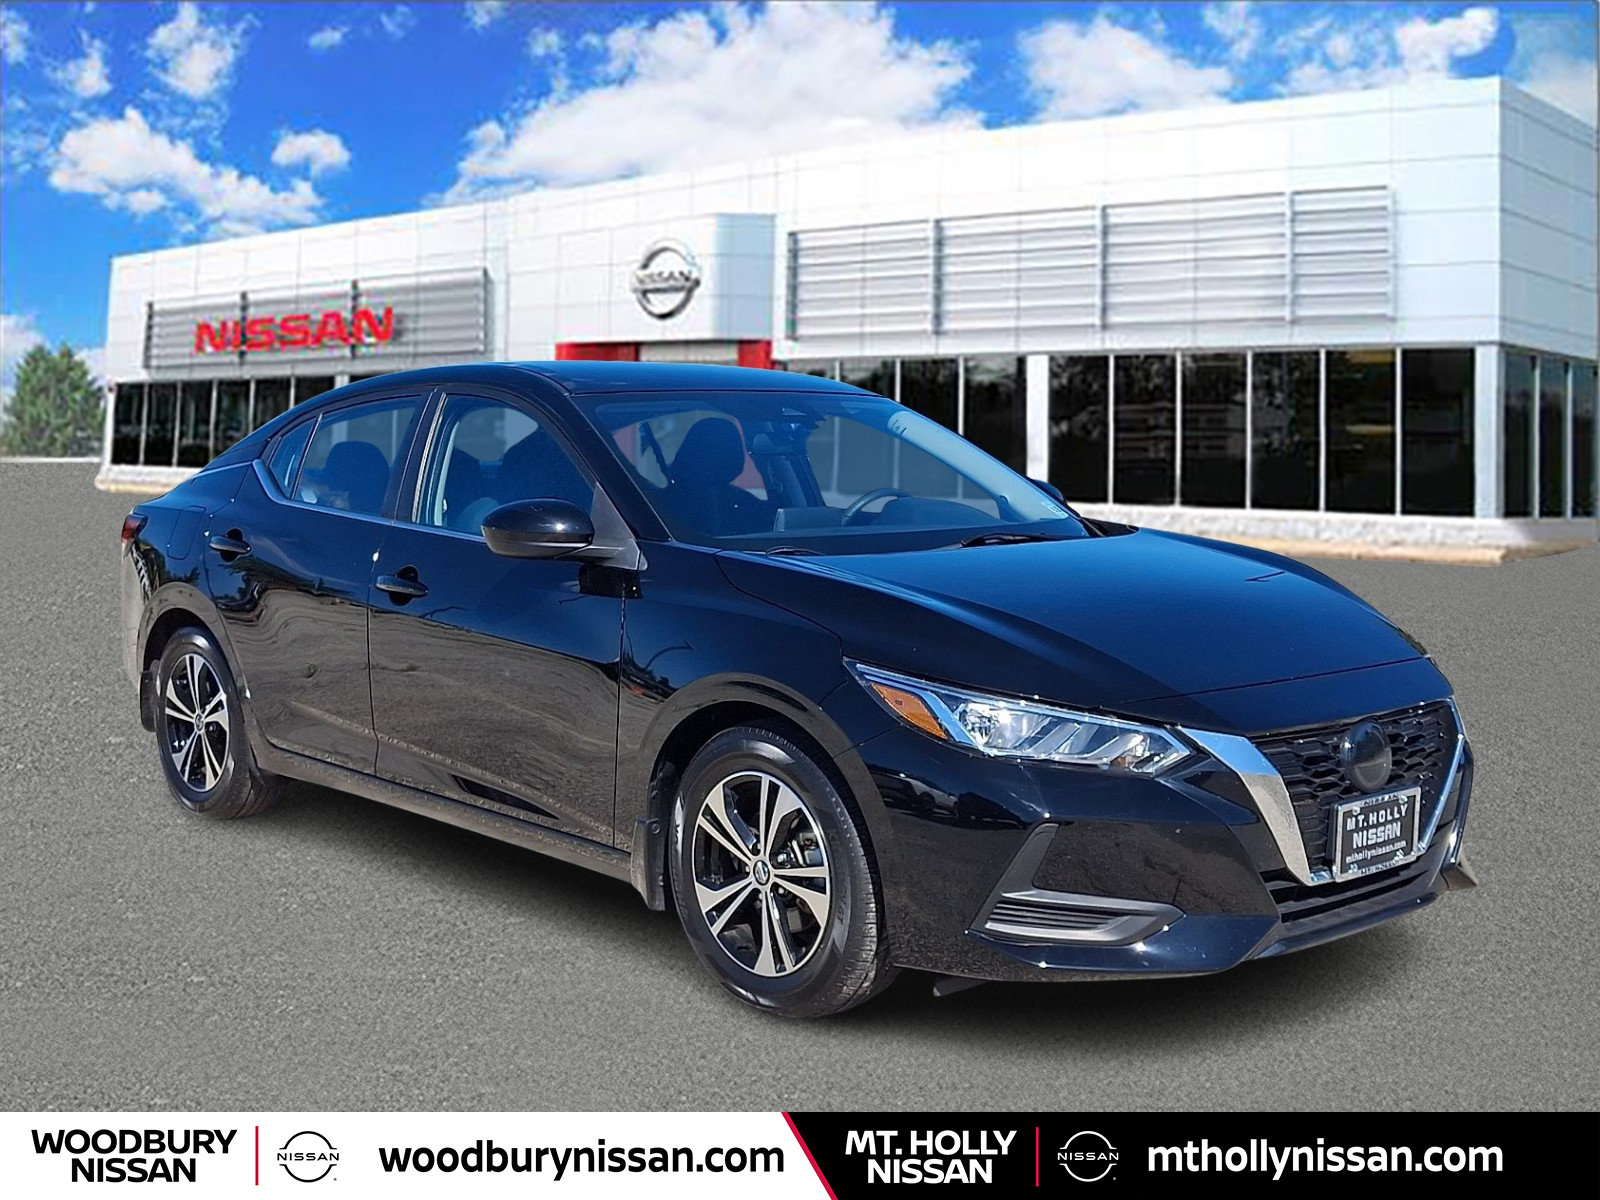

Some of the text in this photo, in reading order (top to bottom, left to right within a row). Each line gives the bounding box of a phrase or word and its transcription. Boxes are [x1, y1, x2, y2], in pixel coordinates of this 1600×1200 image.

[195, 306, 393, 353] NISSAN
[1346, 804, 1408, 831] MT. HOLLY
[1353, 821, 1401, 849] NISSAN
